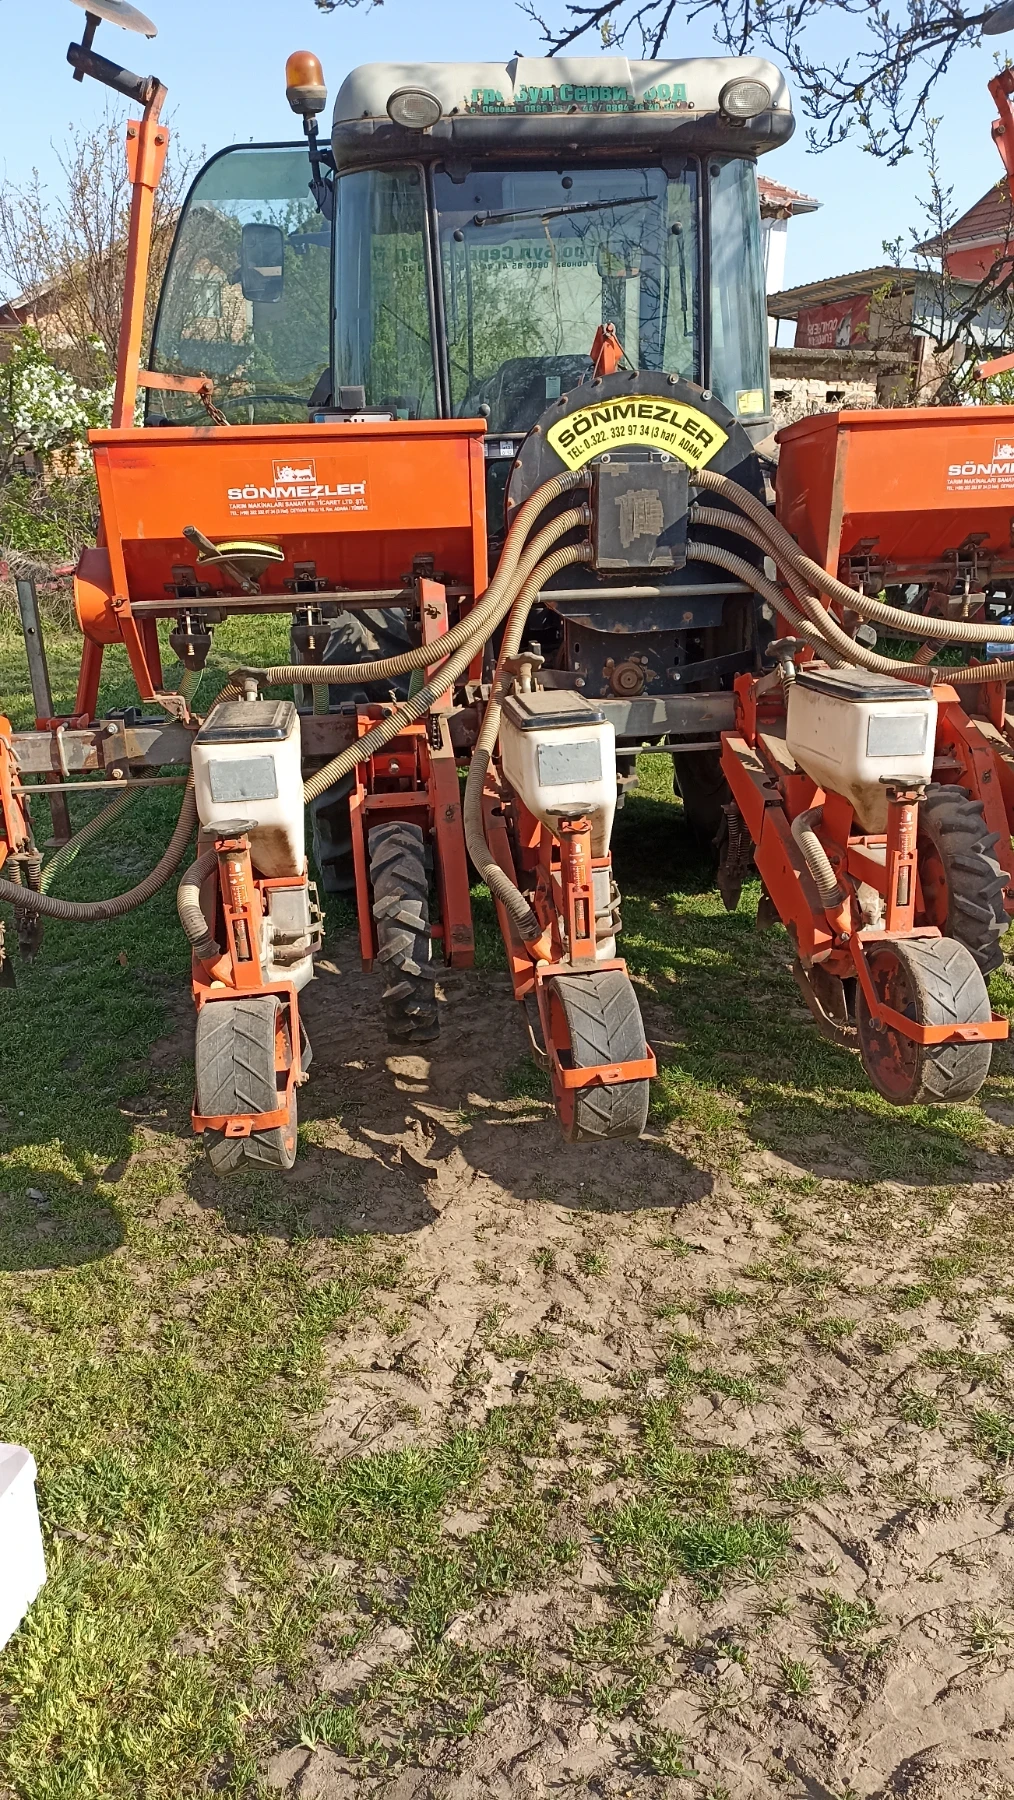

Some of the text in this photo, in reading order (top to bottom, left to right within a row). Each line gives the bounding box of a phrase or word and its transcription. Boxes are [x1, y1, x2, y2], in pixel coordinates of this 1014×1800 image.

[558, 403, 714, 448] SÖNMEZLER
[567, 424, 703, 461] TEL: 0.322. 332 97 34 (3 hat) ADANA
[227, 483, 365, 501] SÖNMEZLER
